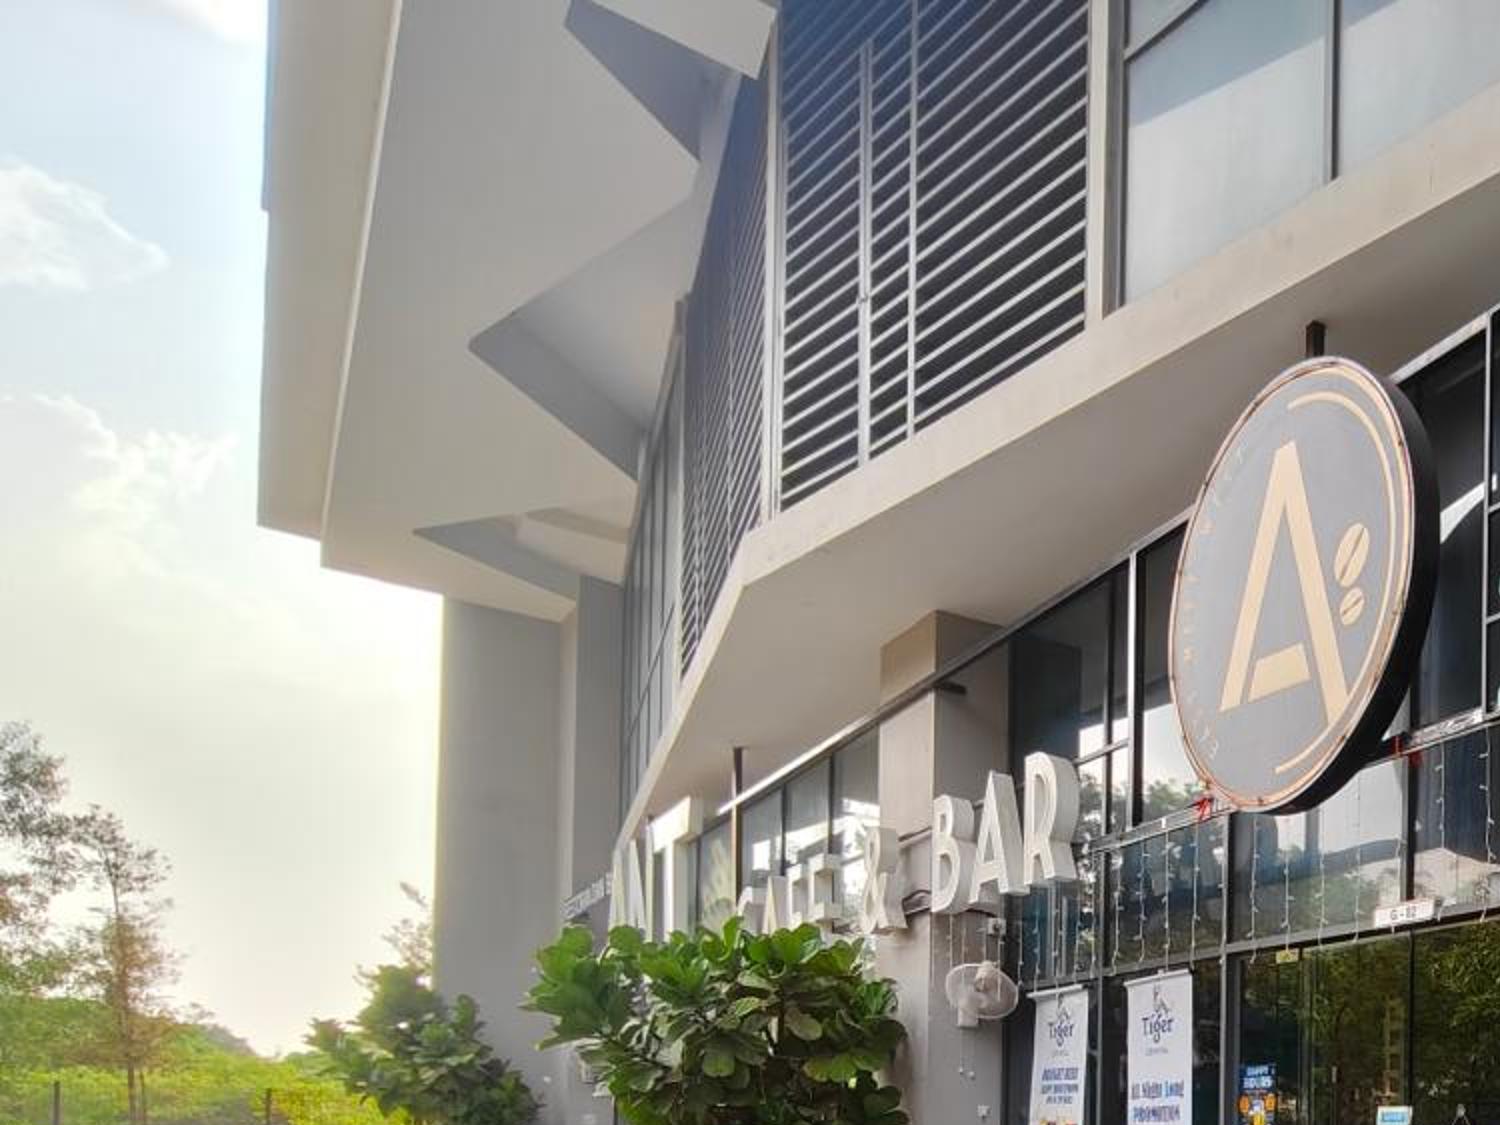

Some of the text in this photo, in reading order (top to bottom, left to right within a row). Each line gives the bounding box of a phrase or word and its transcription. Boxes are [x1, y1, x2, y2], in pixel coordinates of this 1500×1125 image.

[862, 826, 907, 934] &
[931, 750, 1081, 914] BAR
[1048, 1021, 1075, 1047] Tiger
[1141, 1013, 1175, 1044] Tiger
